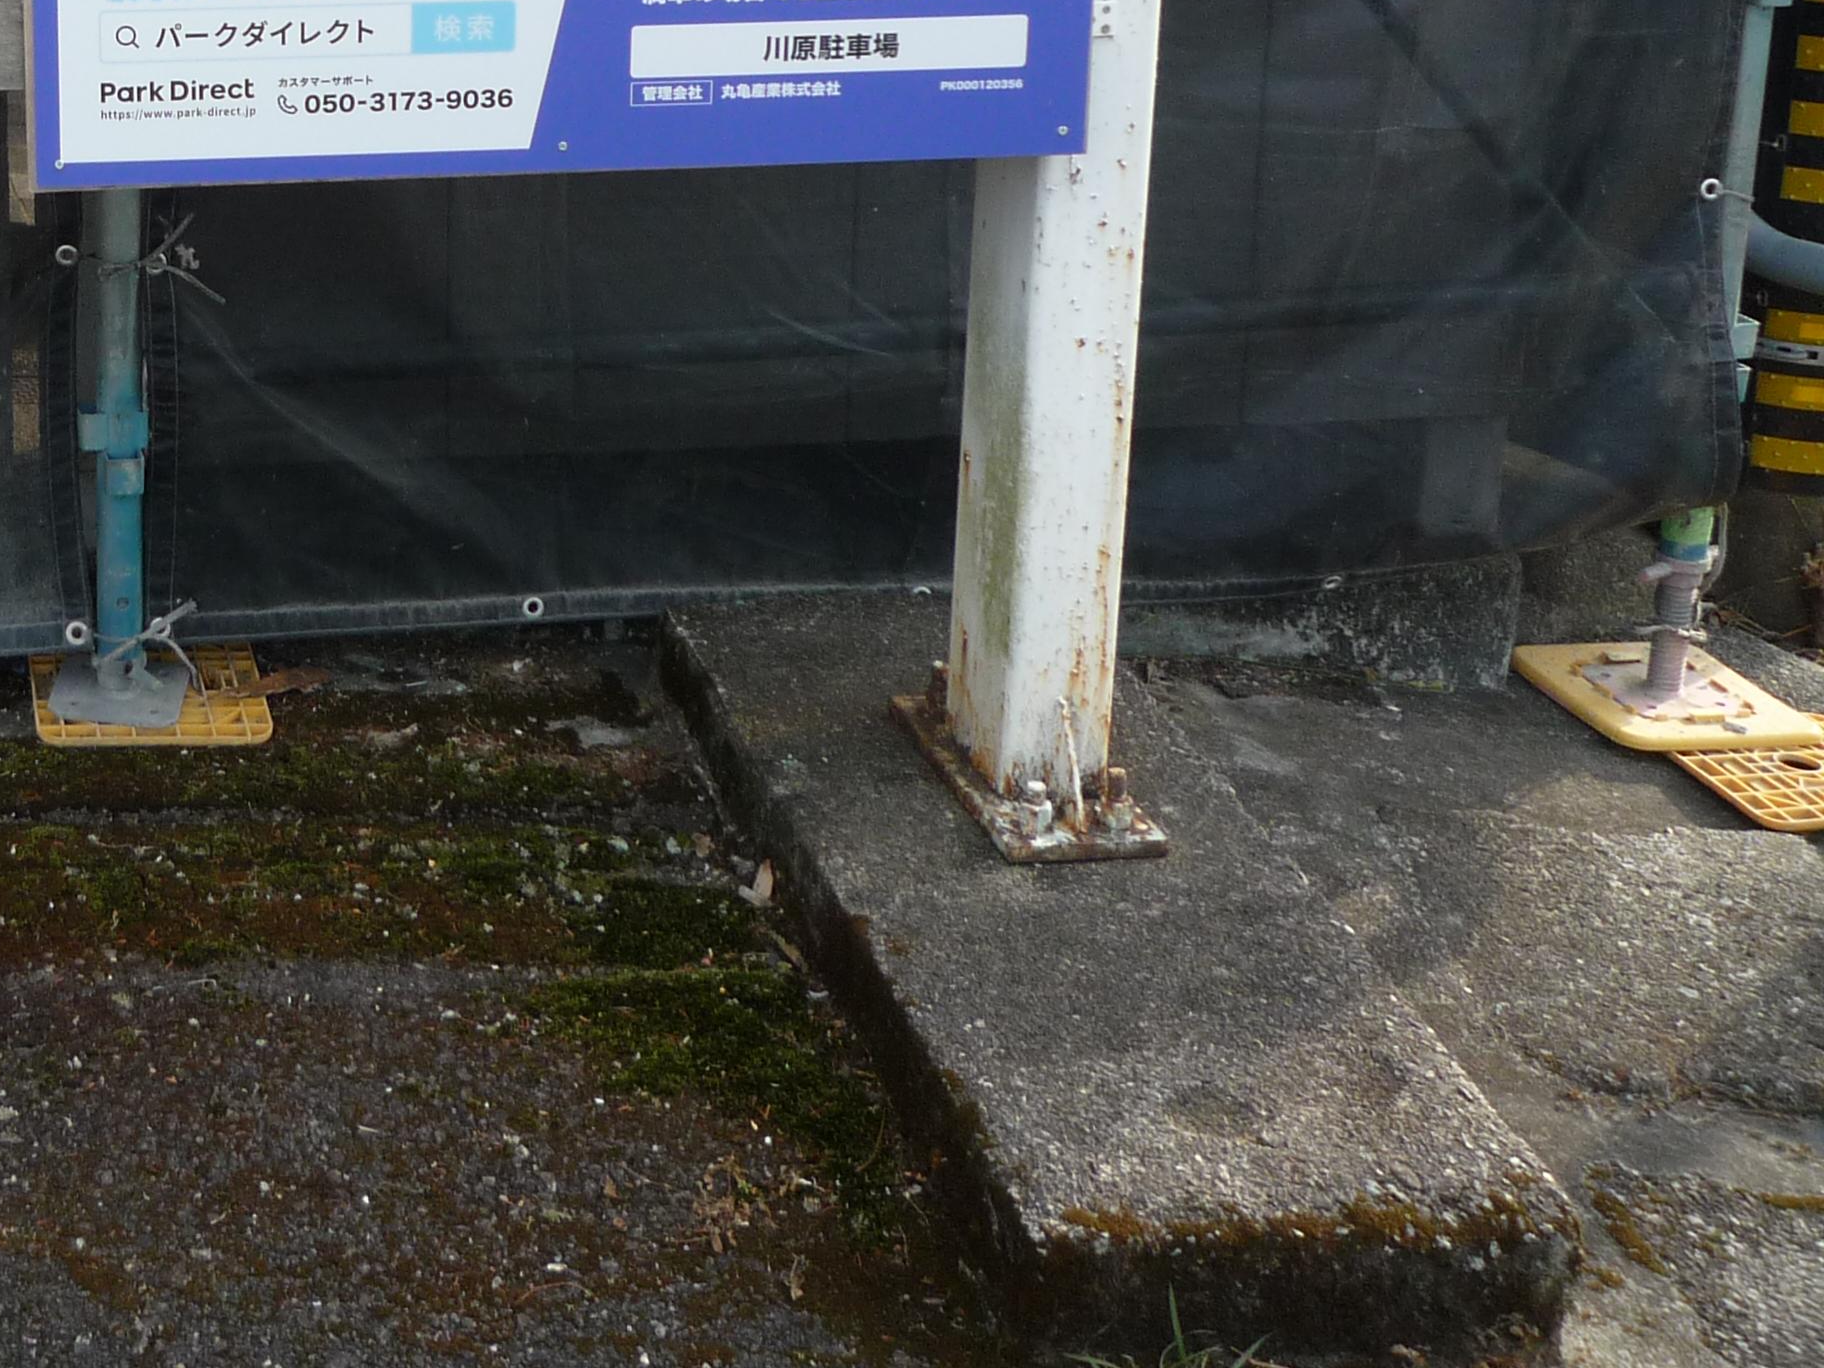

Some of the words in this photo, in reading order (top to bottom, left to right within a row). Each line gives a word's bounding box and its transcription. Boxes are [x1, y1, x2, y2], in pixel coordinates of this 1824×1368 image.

[155, 18, 375, 49] パークダイレクト
[434, 14, 495, 43] 検索
[764, 32, 901, 62] 川原駐車場
[100, 81, 164, 103] Park
[170, 78, 255, 101] Direct
[278, 75, 373, 88] カスタマーサポート
[642, 85, 703, 102] 管理会社
[721, 80, 841, 99] 丸亀産業株式会社
[304, 89, 514, 114] 050-3173-9036
[100, 107, 257, 122] https://www.park-direct.jp
